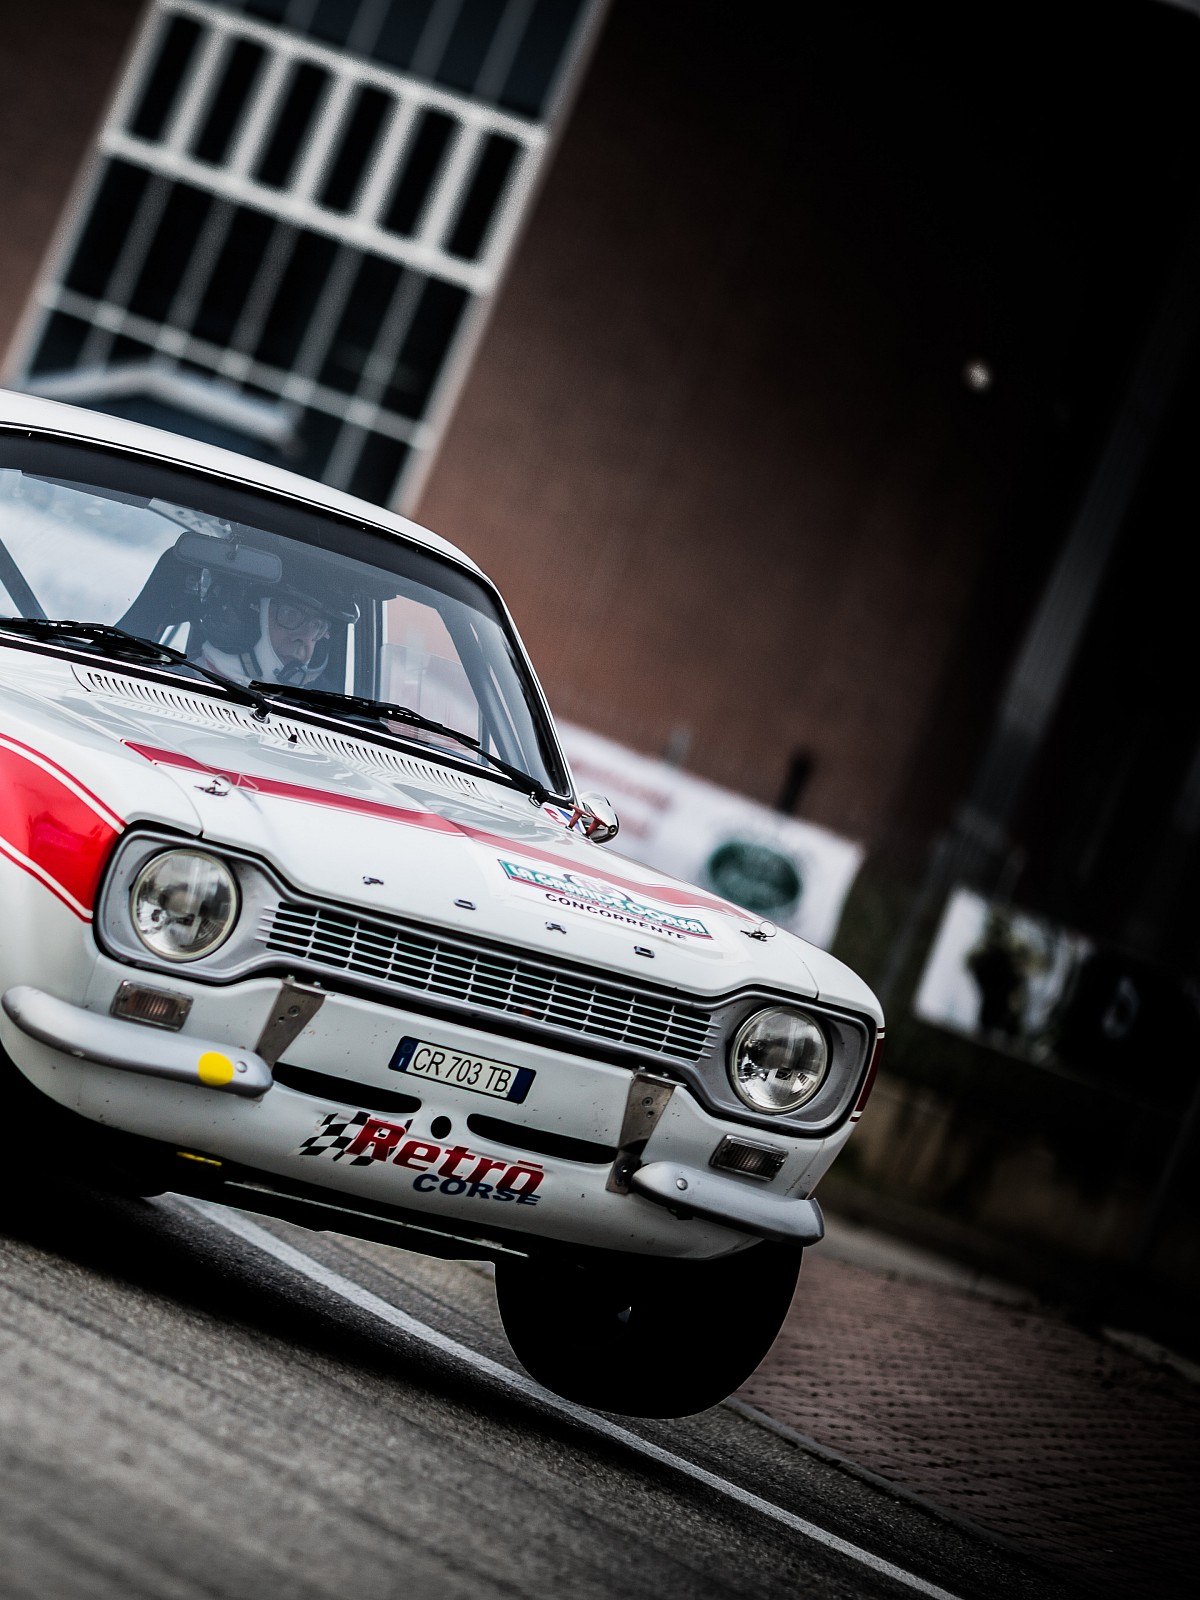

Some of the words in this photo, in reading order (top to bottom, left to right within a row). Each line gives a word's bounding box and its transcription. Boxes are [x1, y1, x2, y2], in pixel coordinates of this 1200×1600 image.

[539, 874, 627, 909] GRANDE
[627, 901, 707, 934] CORSA
[545, 892, 688, 941] CONCORRENTE
[413, 1048, 446, 1077] CR
[445, 1056, 483, 1085] 703
[485, 1065, 512, 1094] TB
[412, 1173, 542, 1207] CORSE
